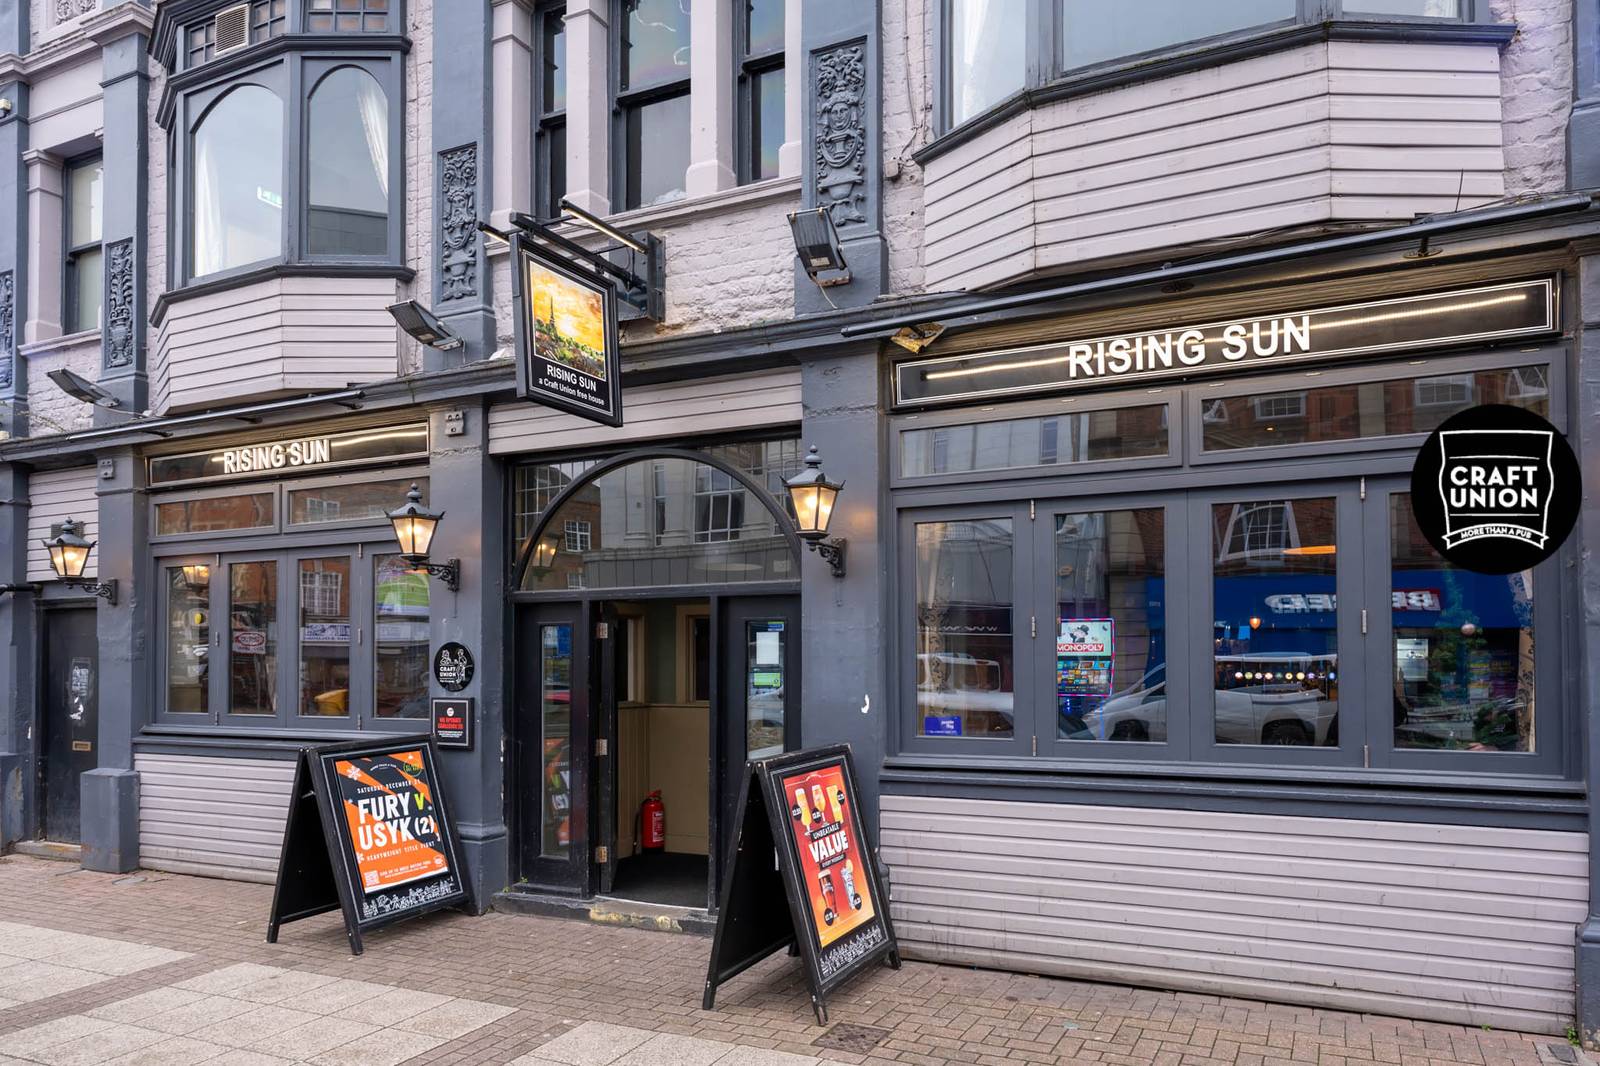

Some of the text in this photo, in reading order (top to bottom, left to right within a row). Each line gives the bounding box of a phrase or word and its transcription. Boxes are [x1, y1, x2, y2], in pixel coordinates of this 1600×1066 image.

[1068, 315, 1310, 378] RISING SUN
[543, 378, 559, 390] Craft
[559, 383, 577, 396] Union
[576, 389, 588, 400] free
[588, 394, 605, 406] house
[547, 364, 597, 392] RISING SUN
[223, 439, 331, 474] RISING SUN
[1057, 644, 1104, 652] MONOPOLY
[357, 792, 411, 824] FURY
[358, 814, 434, 850] USYK (2)
[808, 830, 849, 863] VALUE
[812, 823, 840, 839] UNBEATABLE
